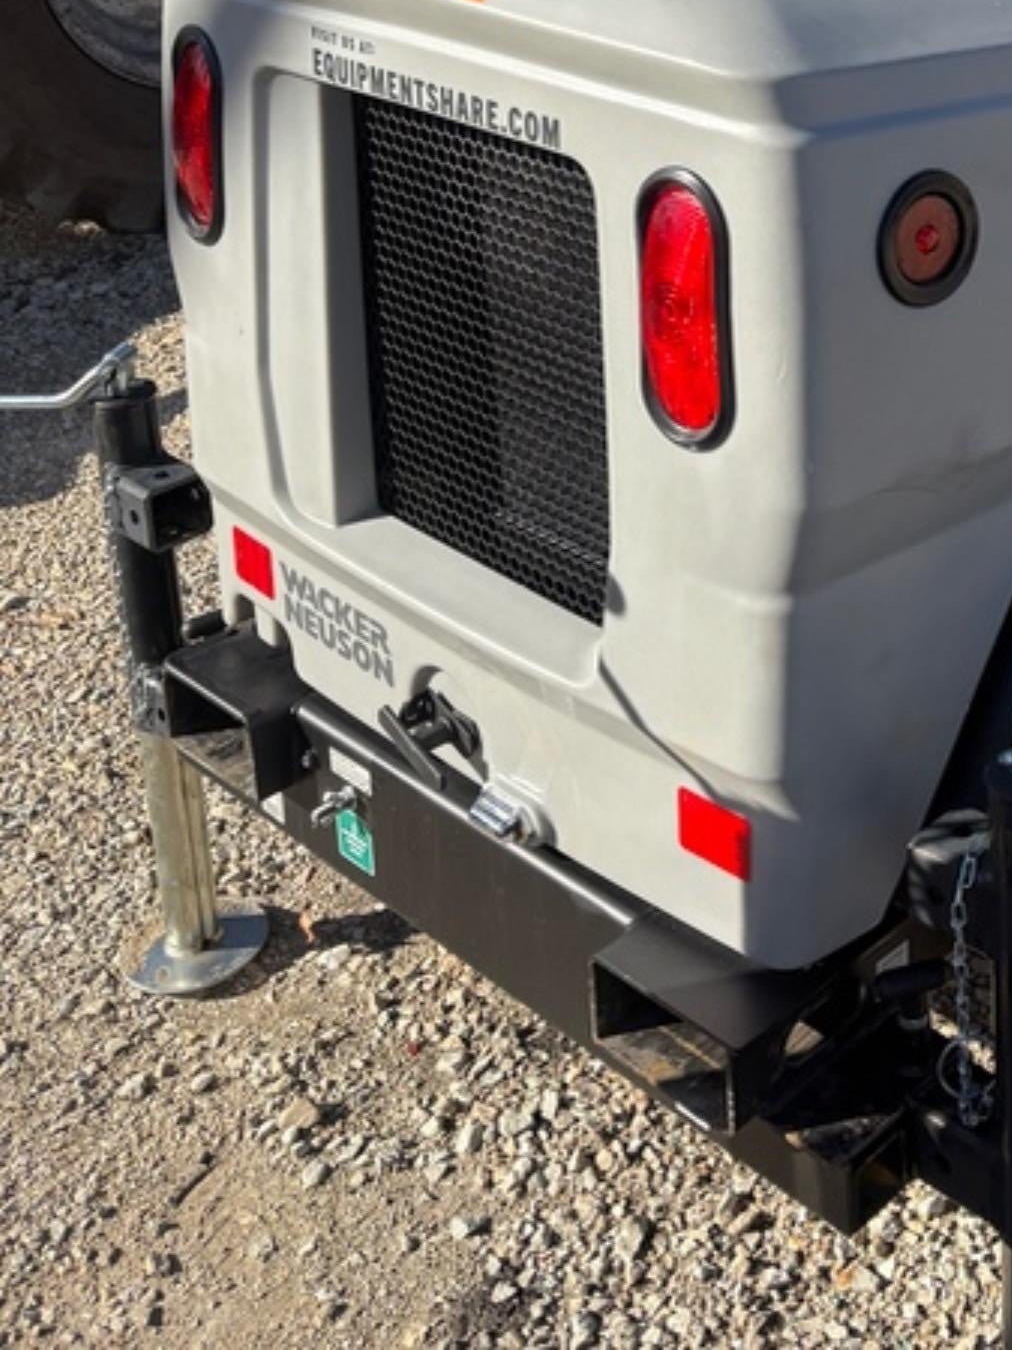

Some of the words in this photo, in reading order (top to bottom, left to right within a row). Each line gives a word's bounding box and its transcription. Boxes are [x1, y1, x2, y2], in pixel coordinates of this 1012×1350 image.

[312, 48, 562, 149] EQUIPMENTSHARE.COM
[280, 561, 391, 655] WACKER
[285, 593, 394, 688] NEUSON
